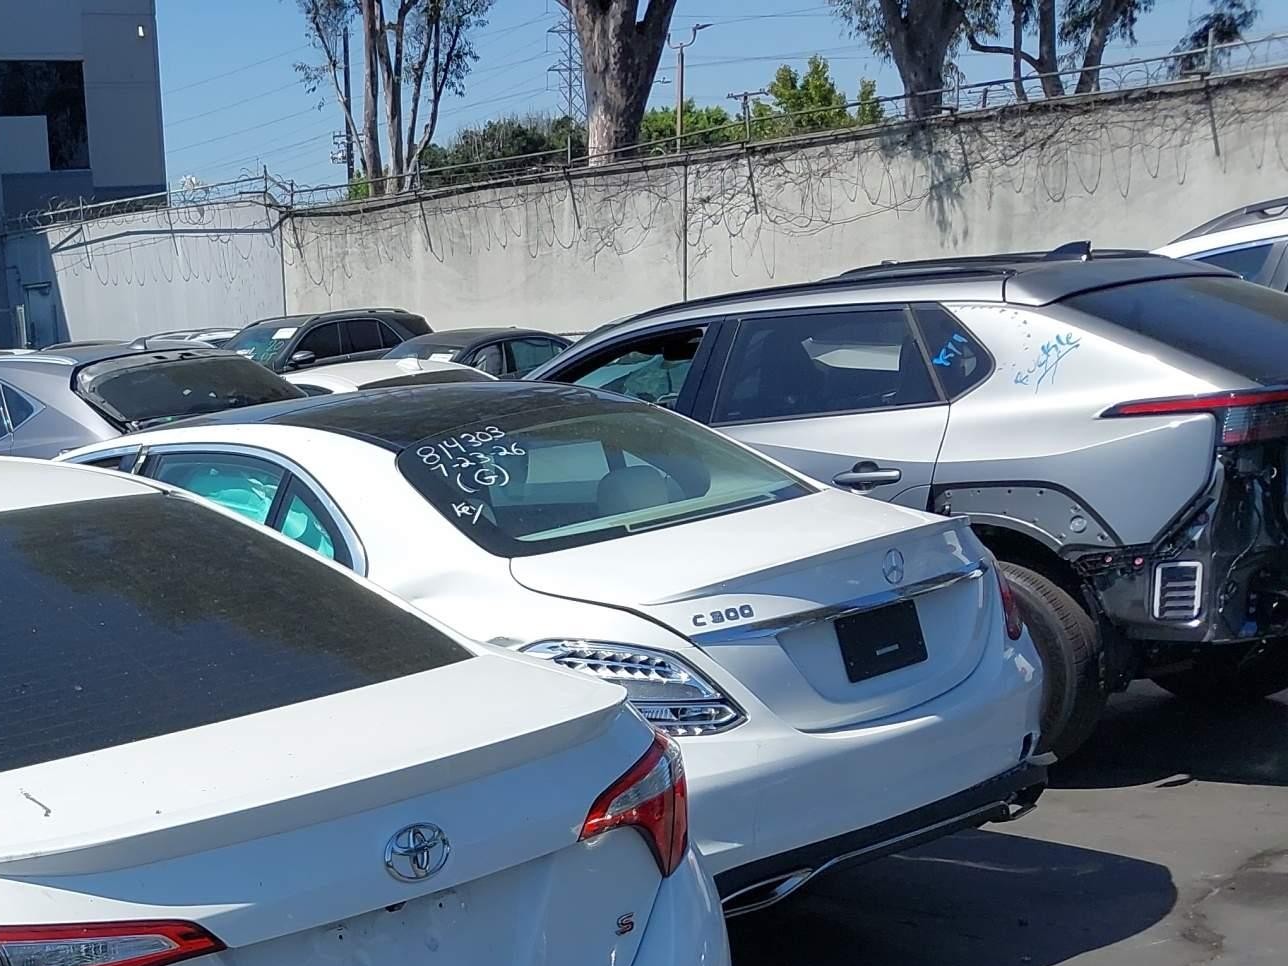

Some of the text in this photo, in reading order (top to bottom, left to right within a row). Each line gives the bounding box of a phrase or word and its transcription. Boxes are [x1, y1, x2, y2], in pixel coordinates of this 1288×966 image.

[692, 604, 754, 627] C 300
[615, 911, 635, 937] S
